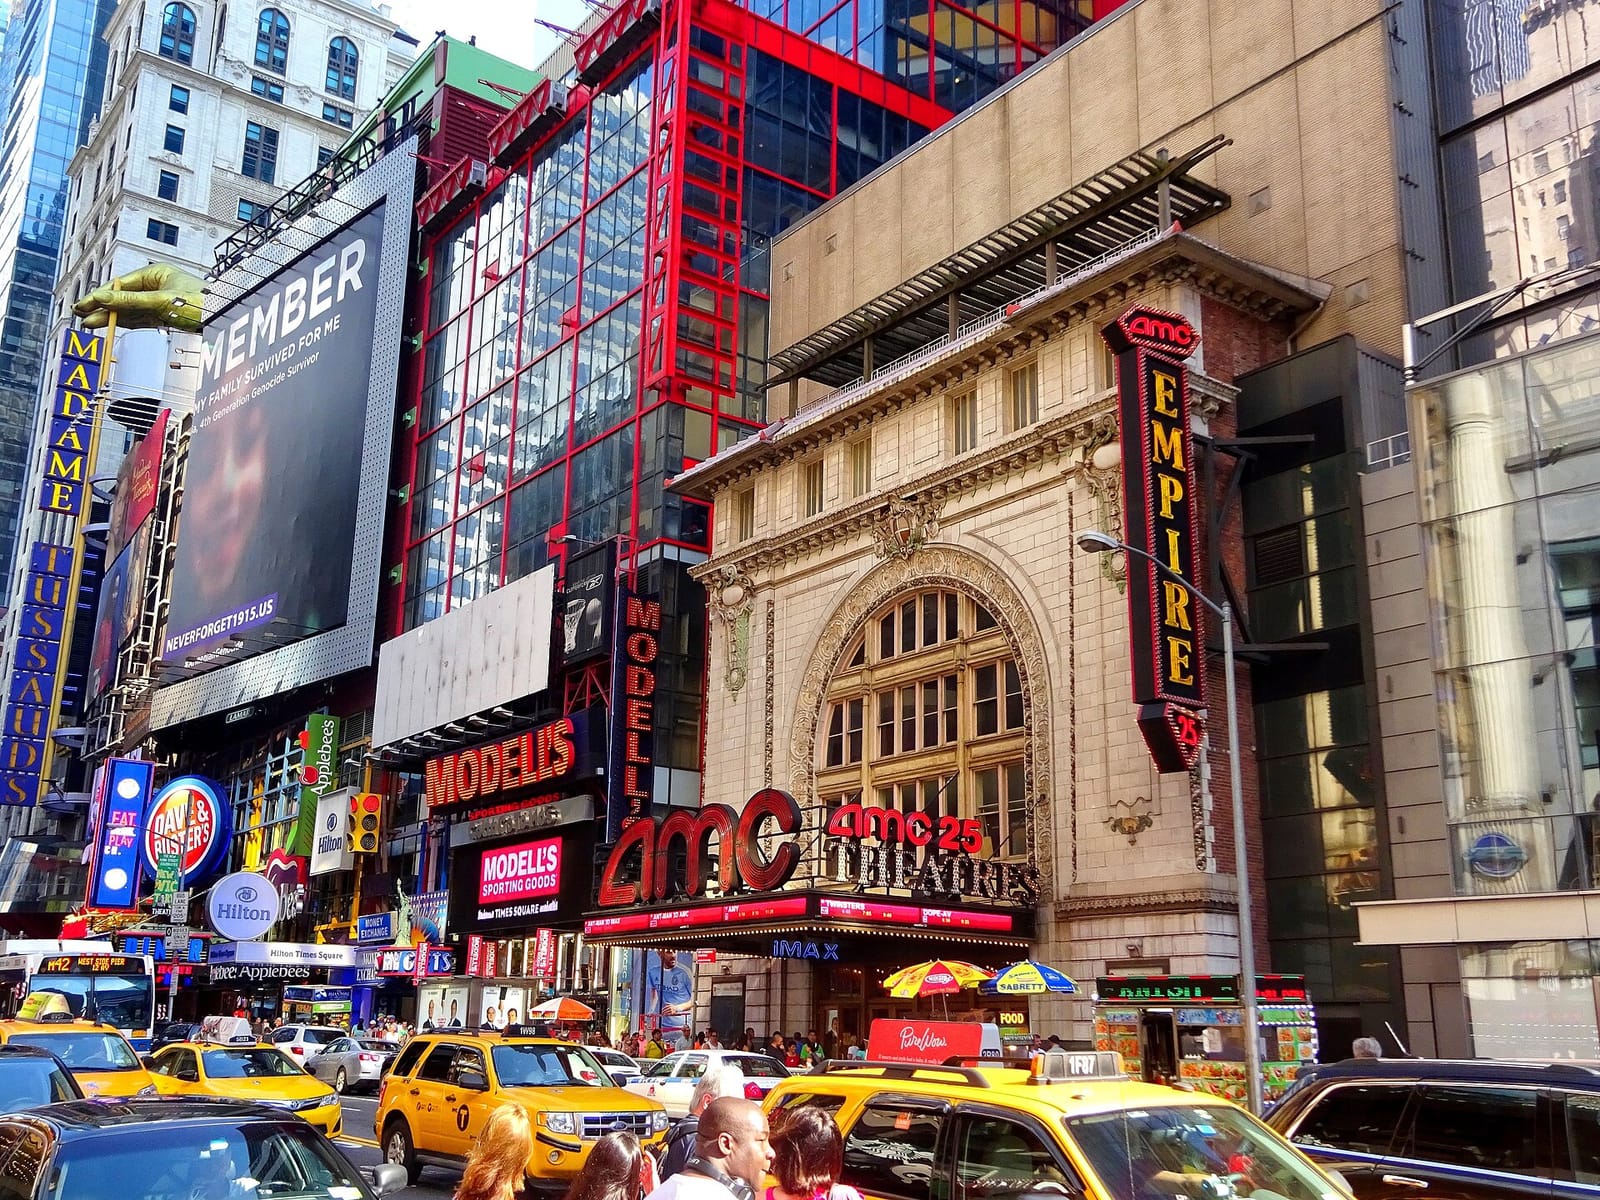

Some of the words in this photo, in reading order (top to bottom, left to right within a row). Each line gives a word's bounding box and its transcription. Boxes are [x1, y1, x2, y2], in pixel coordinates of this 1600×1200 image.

[208, 373, 244, 407] FAMILY
[244, 342, 295, 385] SURVIVED
[298, 331, 321, 353] FOR
[323, 314, 341, 337] ME
[199, 414, 211, 428] 4th
[212, 393, 250, 423] Generation
[251, 370, 286, 399] Genocide
[287, 351, 319, 378] Survivor
[48, 330, 100, 511] MADAME
[1151, 369, 1194, 686] EMPIRE
[165, 598, 274, 653] NEVERFORGET1915.US
[6, 546, 70, 803] TUSSAUDS
[1177, 715, 1198, 746] 25
[310, 719, 335, 795] Applebee's
[197, 800, 209, 822] &
[318, 831, 343, 855] Hilton
[939, 815, 983, 854] 25
[484, 844, 559, 881] MODELL'S
[823, 841, 1041, 905] THEATRES
[482, 878, 525, 897] SPORTING
[525, 873, 557, 891] GOODS
[217, 903, 271, 921] Hilton
[364, 916, 384, 928] MONEY
[494, 906, 513, 919] TIMES
[513, 903, 540, 917] SQUARE
[360, 926, 389, 939] EXCHANGE
[125, 937, 204, 962] DINR
[270, 949, 294, 958] Hilton
[295, 950, 317, 959] Times
[318, 951, 344, 960] Square
[773, 938, 839, 960] IMAX
[47, 957, 71, 971] M42
[78, 957, 94, 966] WEST
[110, 957, 125, 966] PIER
[1000, 983, 1044, 991] SABRETT
[1000, 1012, 1025, 1024] FOOD
